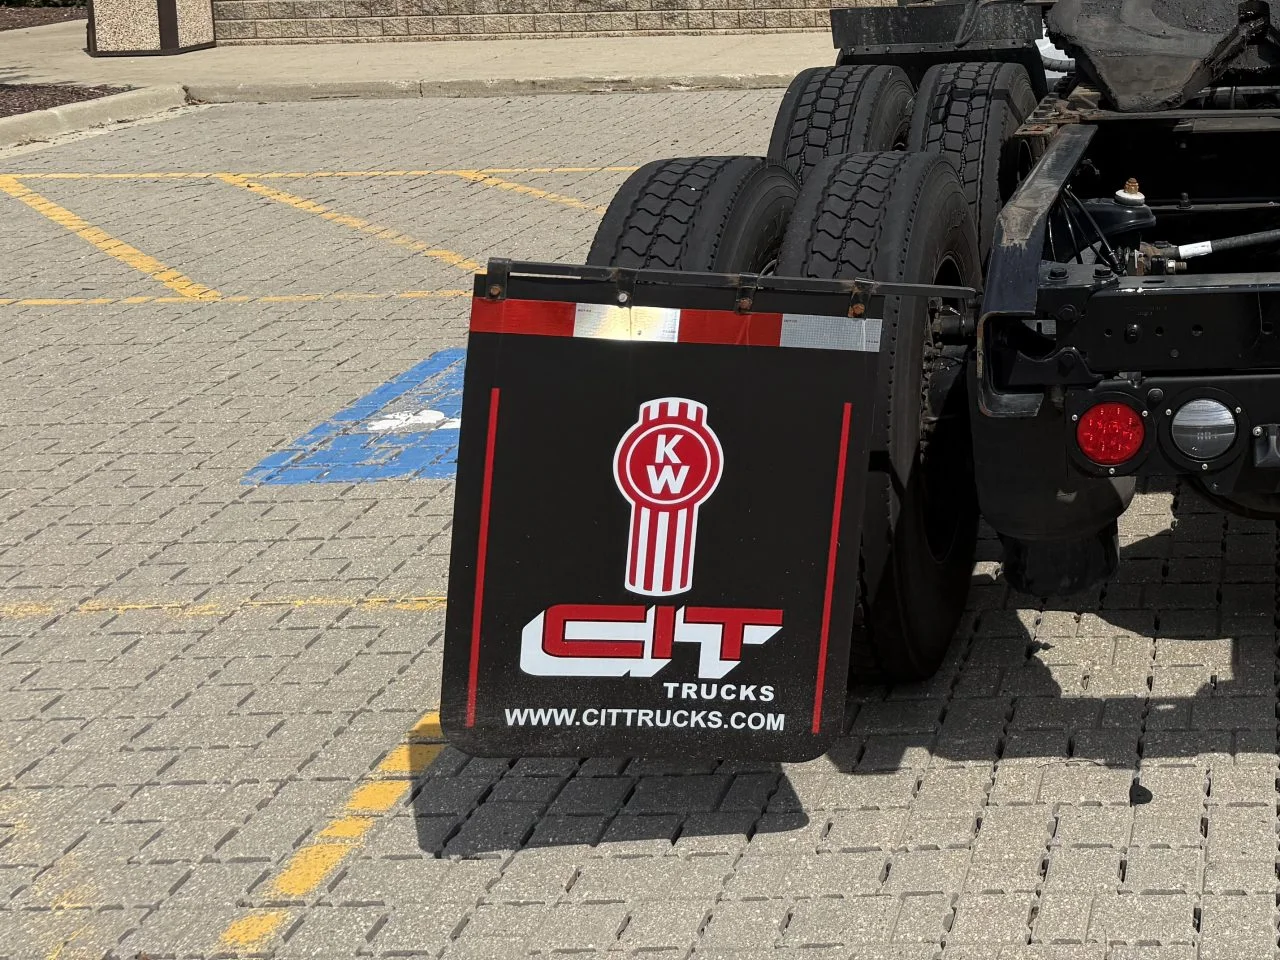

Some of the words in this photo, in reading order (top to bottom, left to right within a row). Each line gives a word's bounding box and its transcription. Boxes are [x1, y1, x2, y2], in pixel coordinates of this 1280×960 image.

[655, 434, 685, 465] K
[646, 464, 692, 495] W
[520, 604, 784, 678] CIT
[663, 682, 776, 702] TRUCKS
[504, 707, 786, 731] WWW.CITTRUCKS.COM
